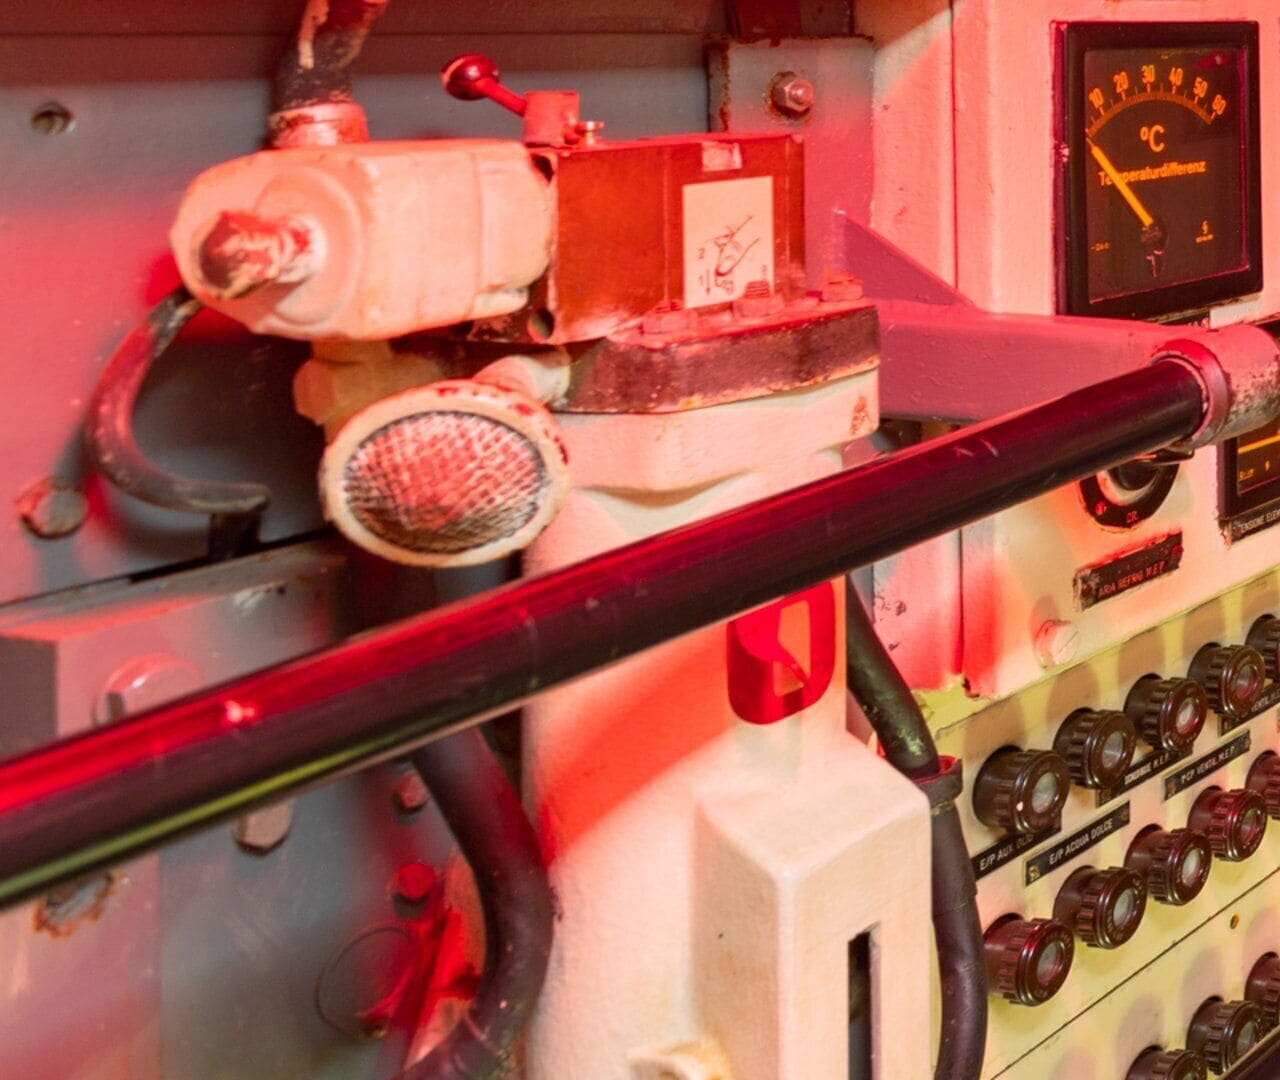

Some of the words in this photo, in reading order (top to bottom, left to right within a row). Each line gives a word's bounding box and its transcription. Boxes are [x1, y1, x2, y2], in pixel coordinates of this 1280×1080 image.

[1112, 71, 1129, 94] 20
[1141, 64, 1155, 85] 30
[1168, 67, 1183, 87] 40
[1089, 87, 1105, 108] 10
[1192, 76, 1208, 98] 50
[1098, 160, 1207, 187] Teperaturdifferenz
[1049, 847, 1065, 865] E/P
[1065, 832, 1090, 856] ACQUA
[1091, 818, 1114, 840] DOLCE
[980, 853, 995, 871] E/P
[997, 844, 1014, 861] AUX
